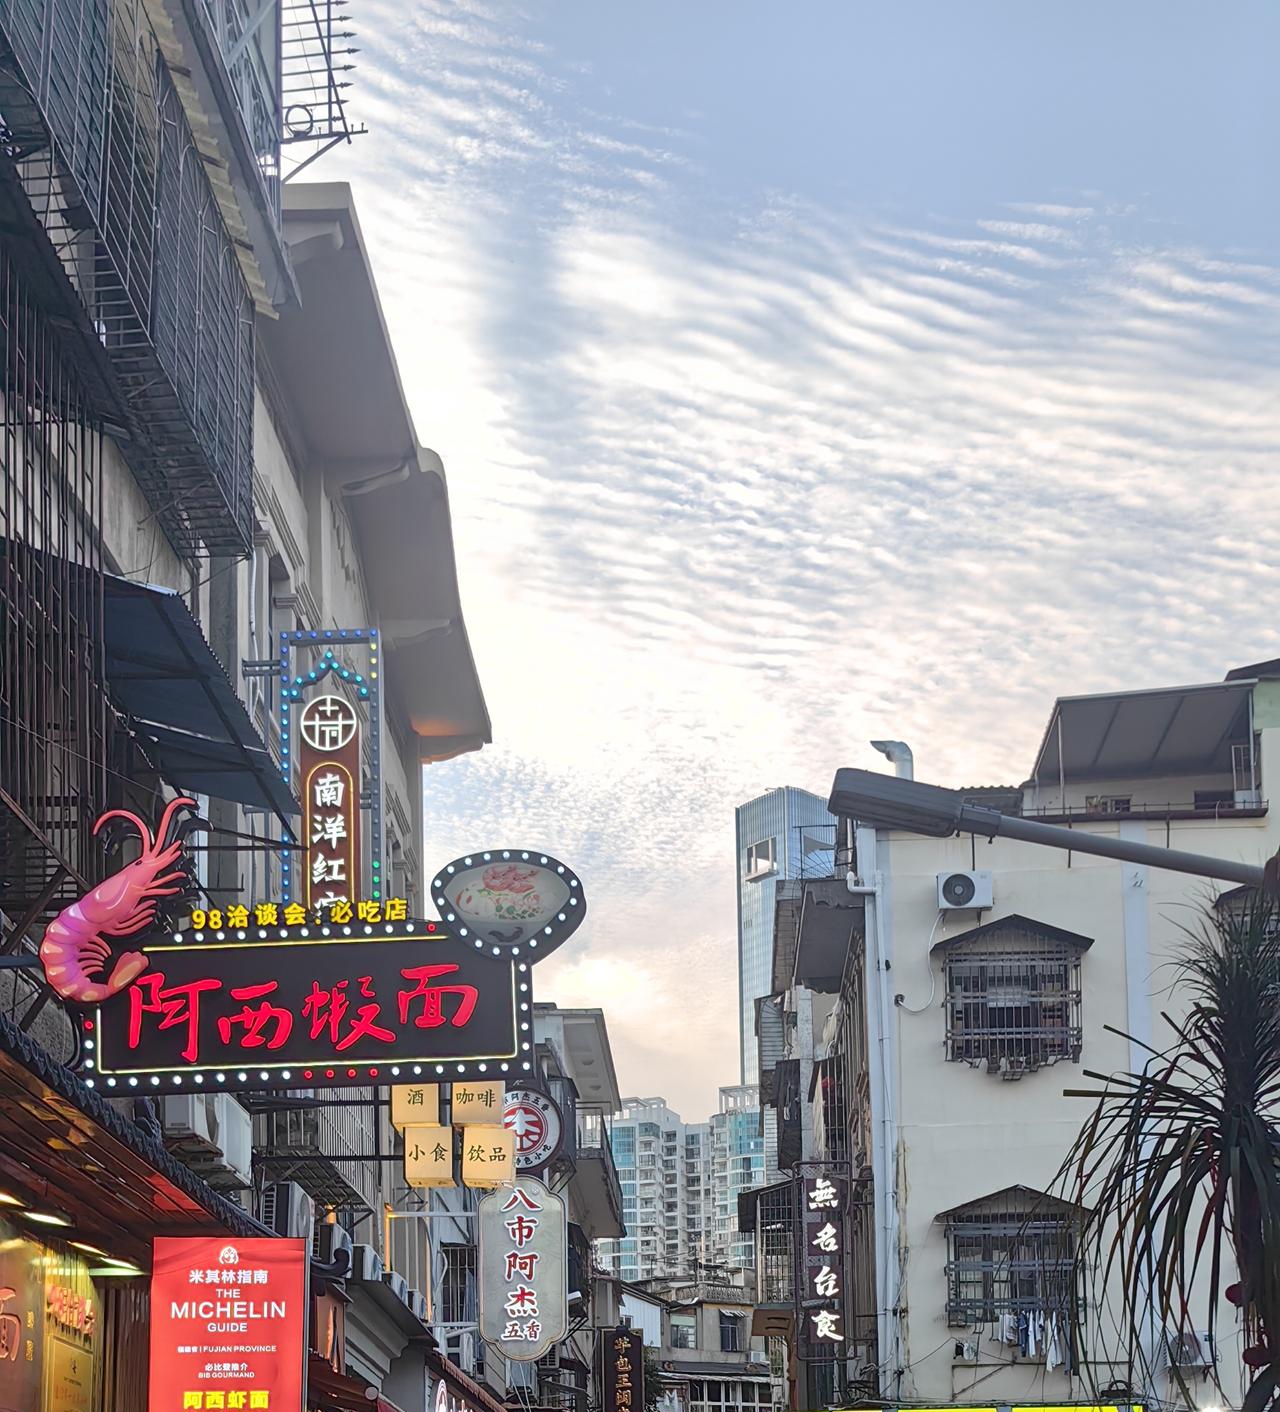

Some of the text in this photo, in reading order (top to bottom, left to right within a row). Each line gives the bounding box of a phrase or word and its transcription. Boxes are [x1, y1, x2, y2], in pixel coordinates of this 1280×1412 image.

[407, 1089, 424, 1106] 酒
[456, 1087, 496, 1108] 咖啡
[408, 1142, 448, 1162] 小食
[468, 1145, 507, 1163] 饮品
[502, 1188, 542, 1316] 八市阿杰
[189, 1269, 269, 1284] 米其林指南
[216, 1289, 240, 1298] THE
[171, 1301, 286, 1318] MICHELIN
[207, 1323, 247, 1332] GUIDE
[502, 1321, 541, 1341] 五香
[203, 1345, 232, 1353] FUJIAN
[233, 1345, 276, 1353] PROVINCE
[183, 1391, 269, 1409] 阿西虾面
